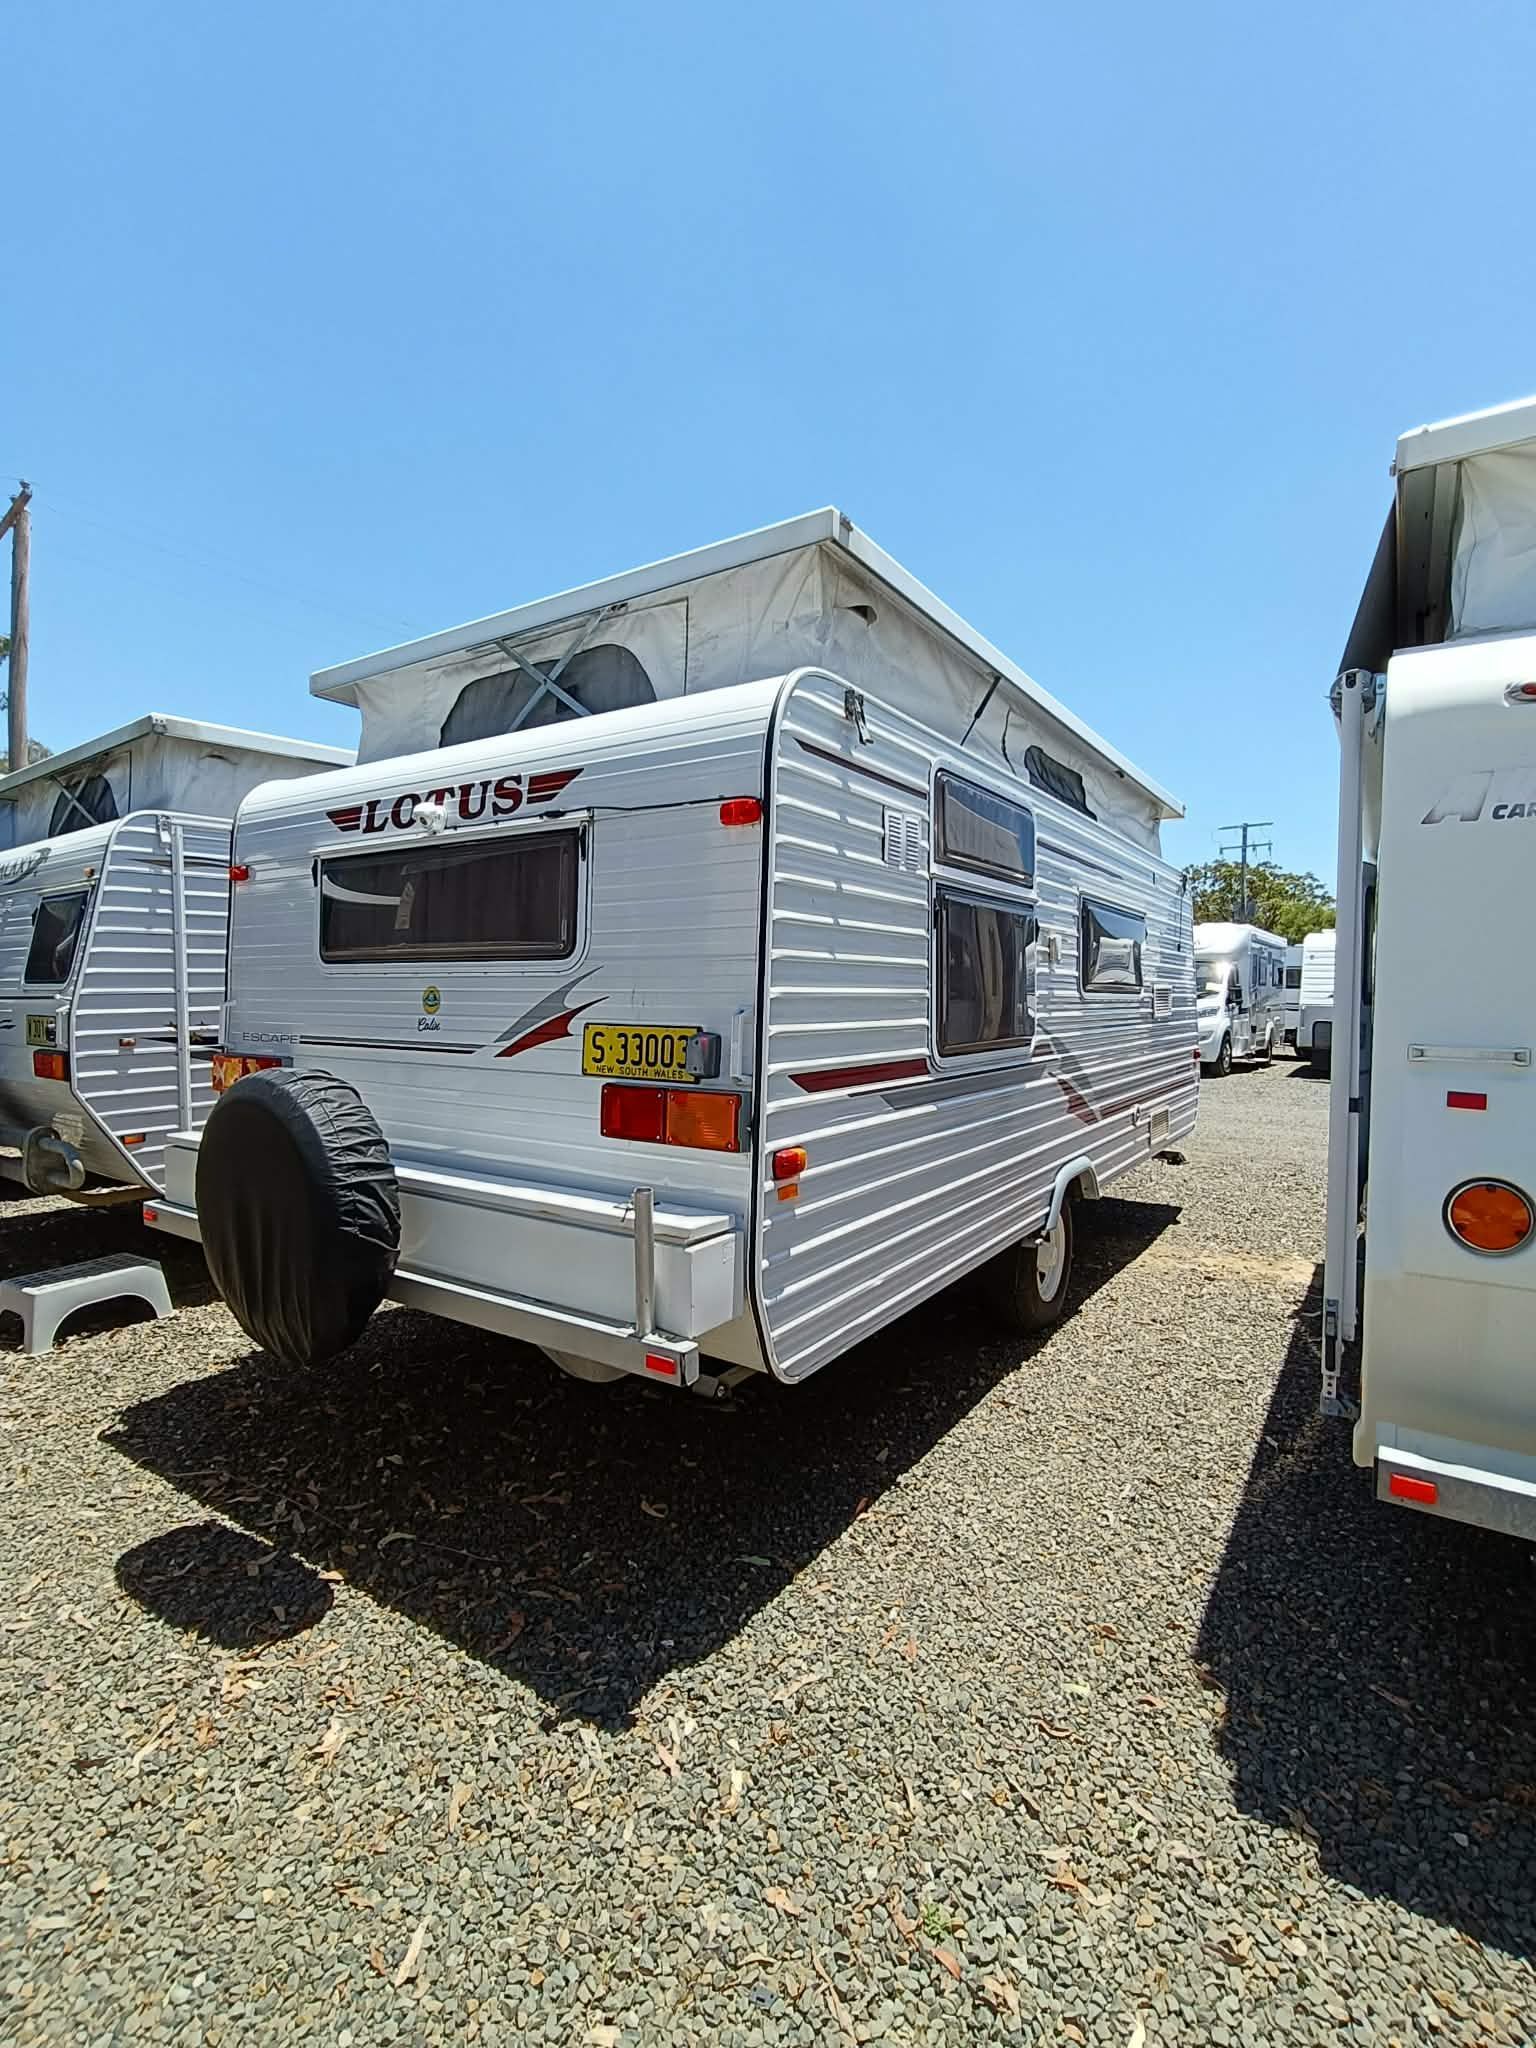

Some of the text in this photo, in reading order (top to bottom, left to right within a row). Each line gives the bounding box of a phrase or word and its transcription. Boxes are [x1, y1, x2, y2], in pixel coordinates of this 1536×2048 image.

[362, 775, 523, 834] LOTUS
[242, 1032, 300, 1045] ESCAPE
[596, 1065, 684, 1080] NEW SOUTH WALES
